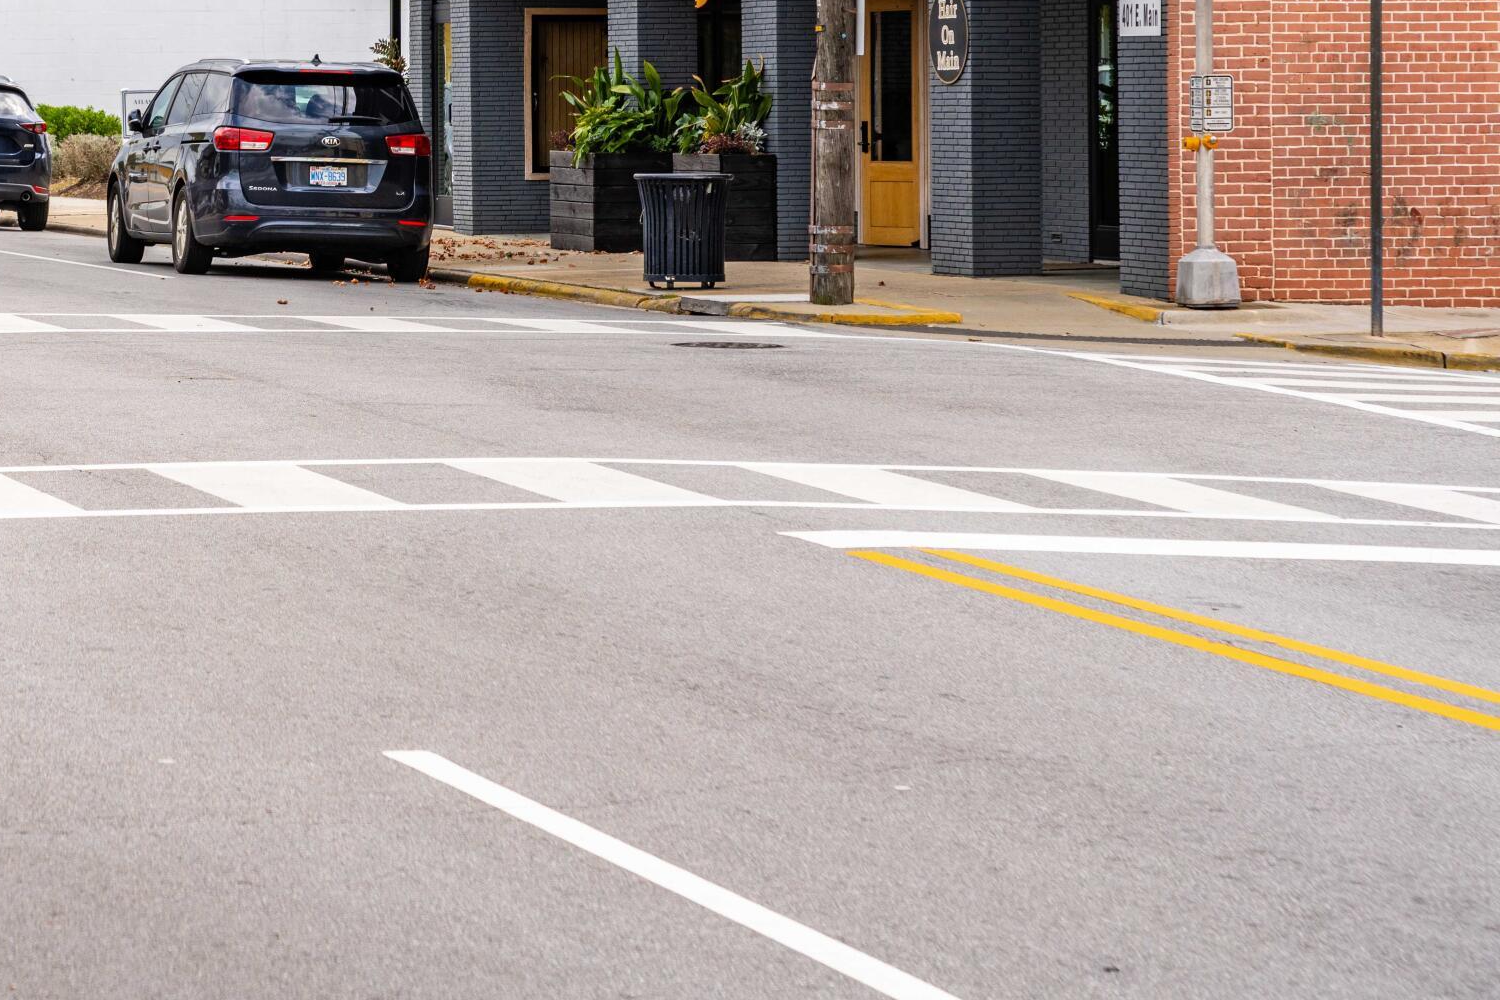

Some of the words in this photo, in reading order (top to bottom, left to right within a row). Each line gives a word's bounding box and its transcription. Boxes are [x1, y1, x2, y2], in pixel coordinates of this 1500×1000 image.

[1122, 3, 1133, 28] 401
[1135, 3, 1142, 27] E.
[1143, 2, 1159, 27] Main
[940, 24, 955, 45] On
[936, 49, 960, 71] Main
[324, 138, 339, 146] KIA
[310, 171, 346, 182] WNX-8639
